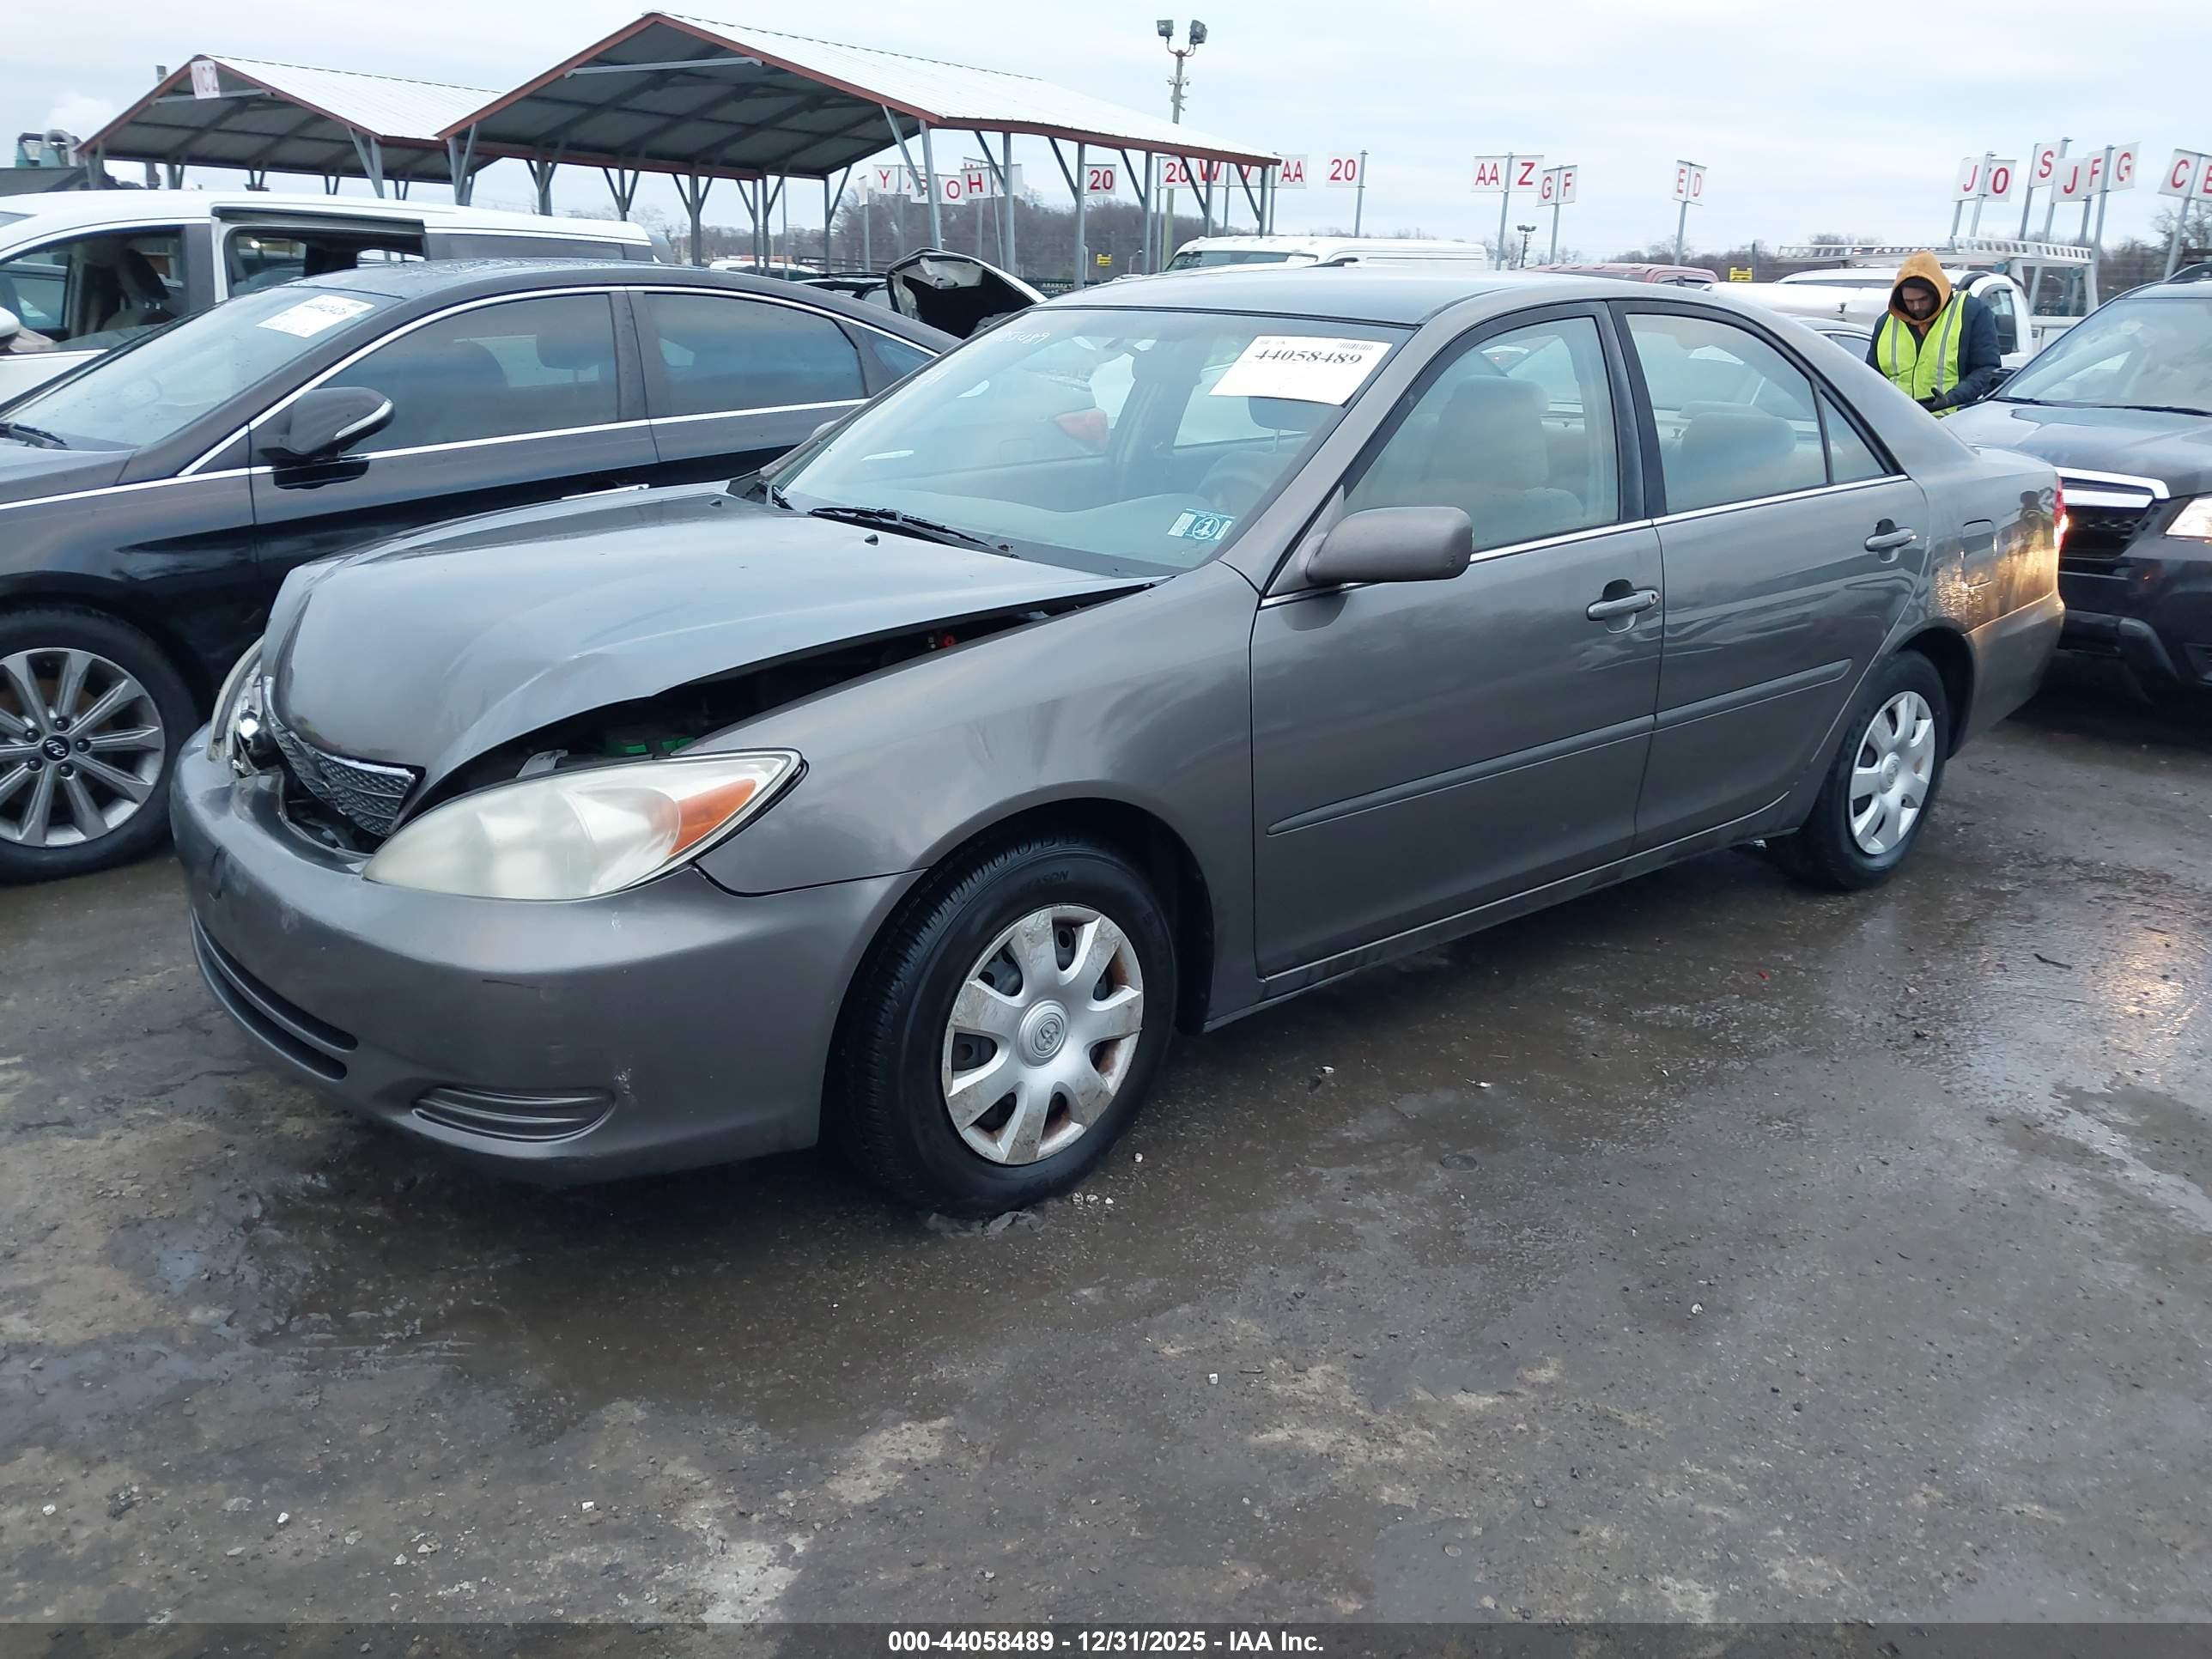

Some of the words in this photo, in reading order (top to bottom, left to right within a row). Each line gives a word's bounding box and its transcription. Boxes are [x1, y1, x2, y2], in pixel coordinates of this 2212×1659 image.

[1165, 162, 1188, 183] 20
[1281, 161, 1304, 182] AA
[1329, 159, 1356, 181] 20
[1474, 162, 1499, 185] AA
[1517, 162, 1535, 185] Z
[2038, 150, 2054, 179] S
[2087, 158, 2102, 187] F
[2117, 152, 2132, 182] G
[2171, 159, 2190, 188] C
[878, 170, 891, 189] Y
[946, 180, 961, 199] O
[967, 173, 983, 193] H
[1089, 170, 1114, 191] 20
[1541, 176, 1553, 199] G
[1563, 173, 1572, 197] F
[1676, 168, 1686, 194] E
[1692, 173, 1702, 198] D
[1963, 165, 1978, 192] J
[2063, 166, 2078, 194] J
[1255, 349, 1363, 365] 44058489
